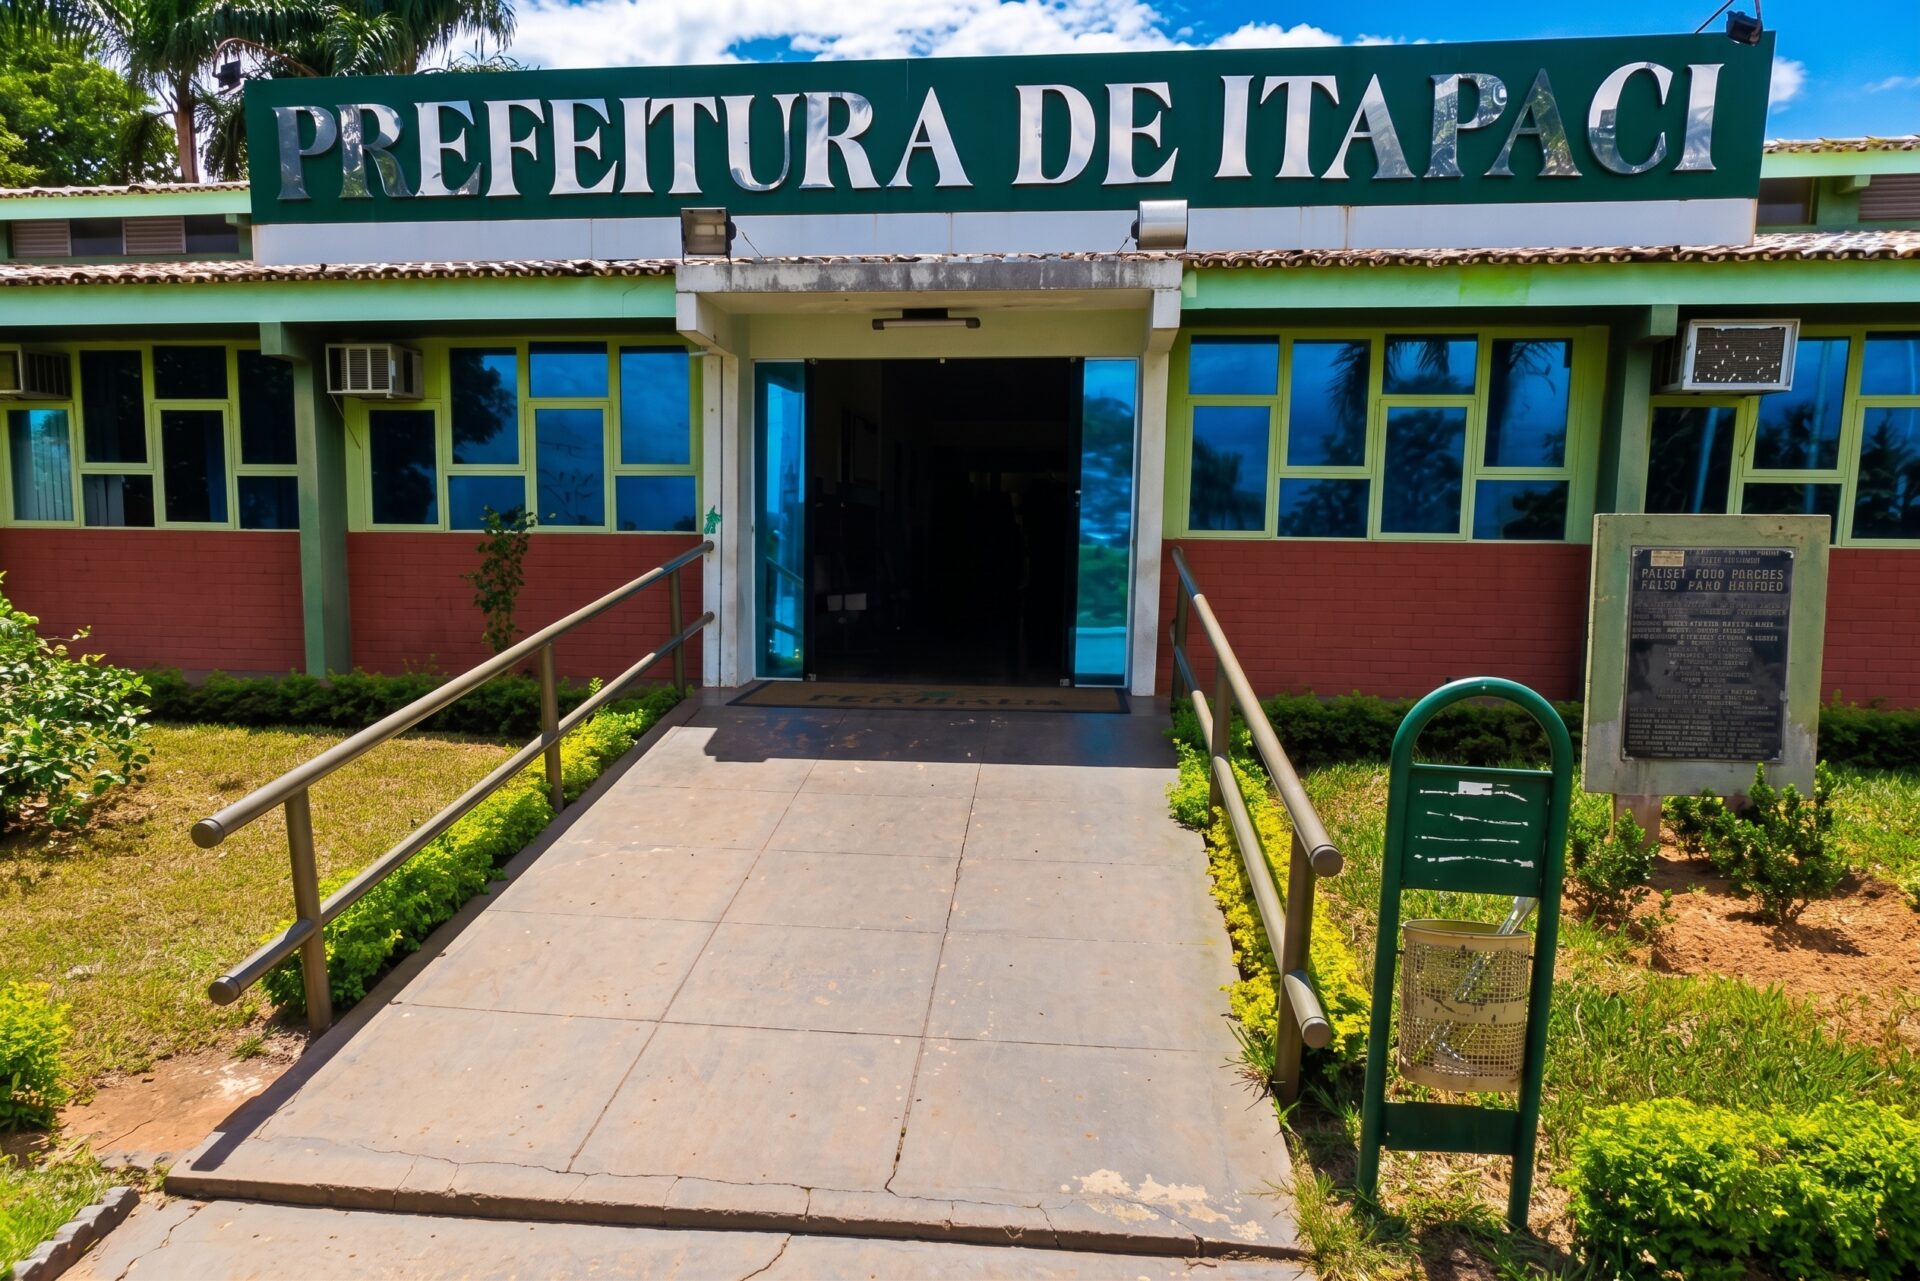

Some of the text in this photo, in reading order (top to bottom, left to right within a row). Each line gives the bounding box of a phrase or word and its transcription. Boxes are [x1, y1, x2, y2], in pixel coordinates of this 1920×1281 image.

[272, 61, 1725, 200] PREFEITURA DE ITAPACI
